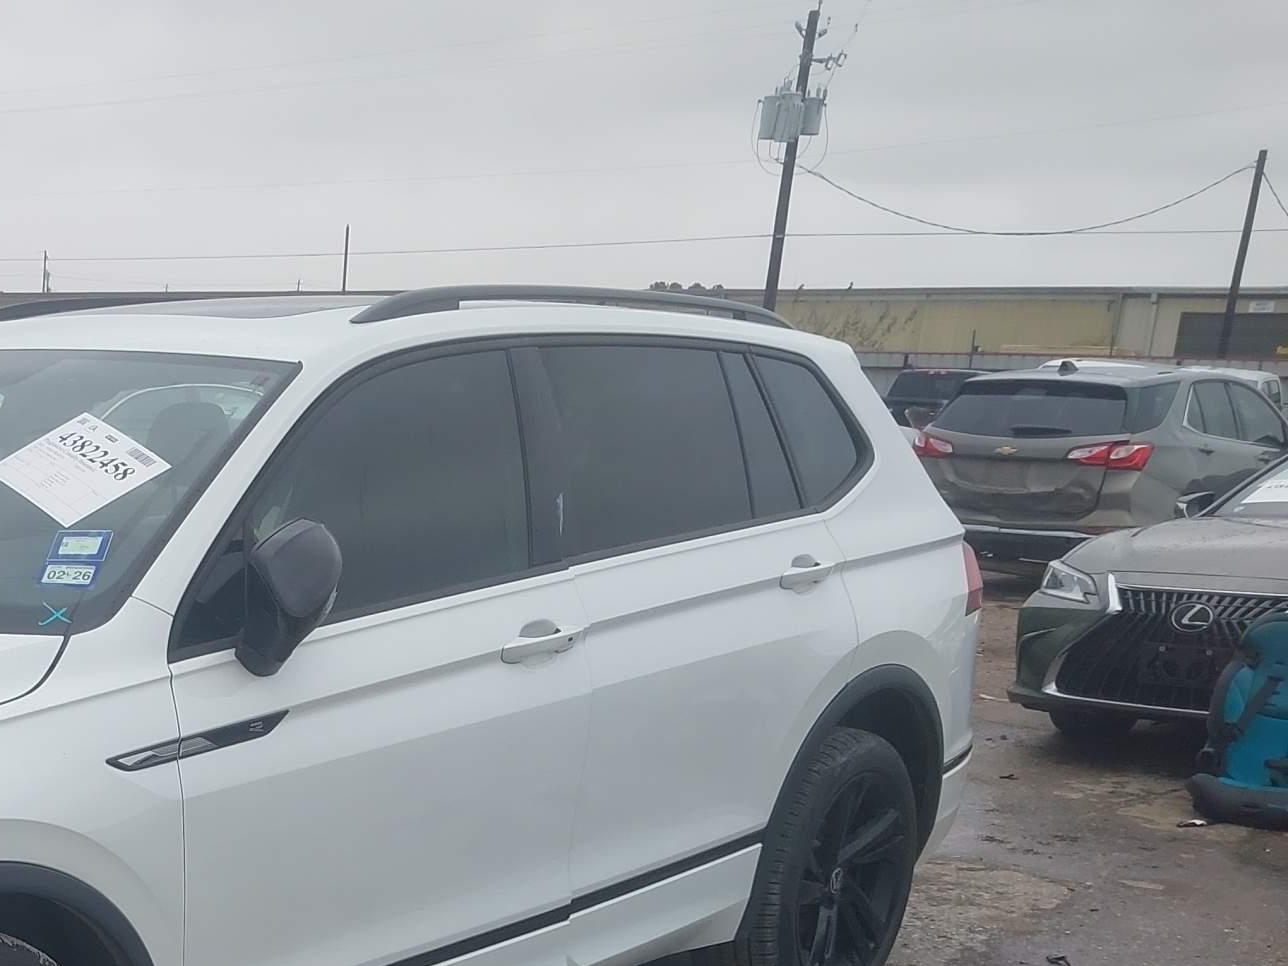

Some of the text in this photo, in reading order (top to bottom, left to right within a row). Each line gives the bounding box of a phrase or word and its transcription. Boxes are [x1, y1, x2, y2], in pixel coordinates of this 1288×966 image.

[58, 431, 136, 481] 43822458
[47, 570, 92, 581] 02 26
